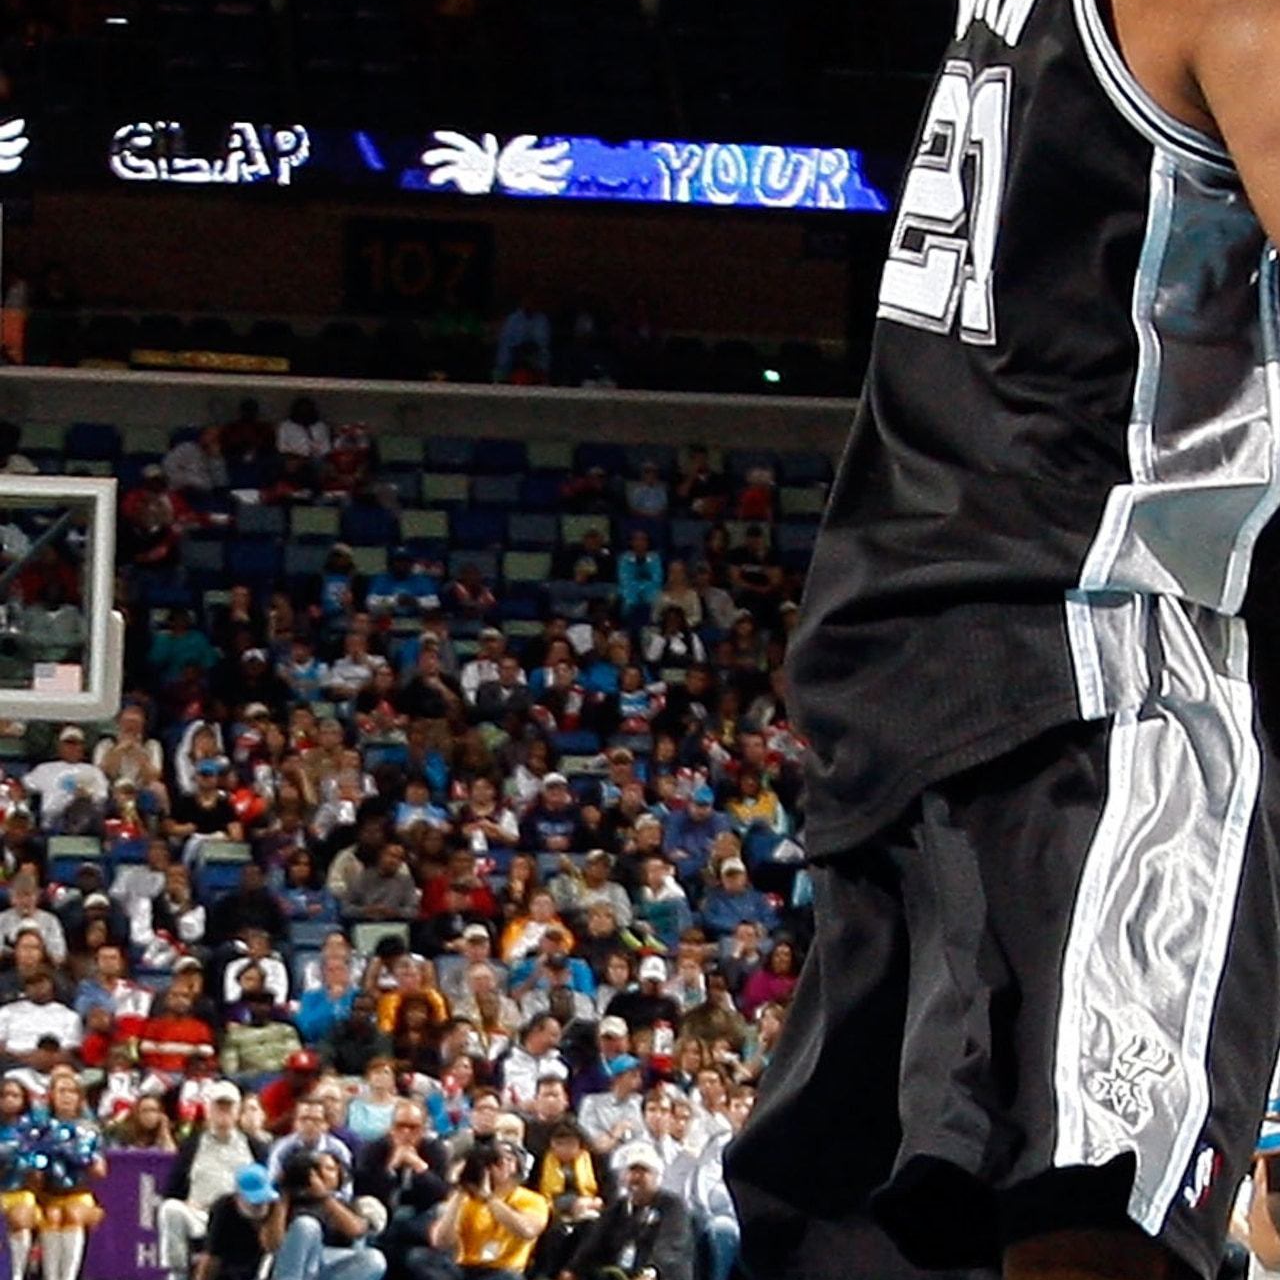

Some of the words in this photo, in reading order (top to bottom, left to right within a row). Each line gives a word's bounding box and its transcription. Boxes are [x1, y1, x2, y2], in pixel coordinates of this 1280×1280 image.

[109, 121, 309, 185] CLAP
[657, 142, 849, 208] YOUR
[877, 60, 1013, 345] 21
